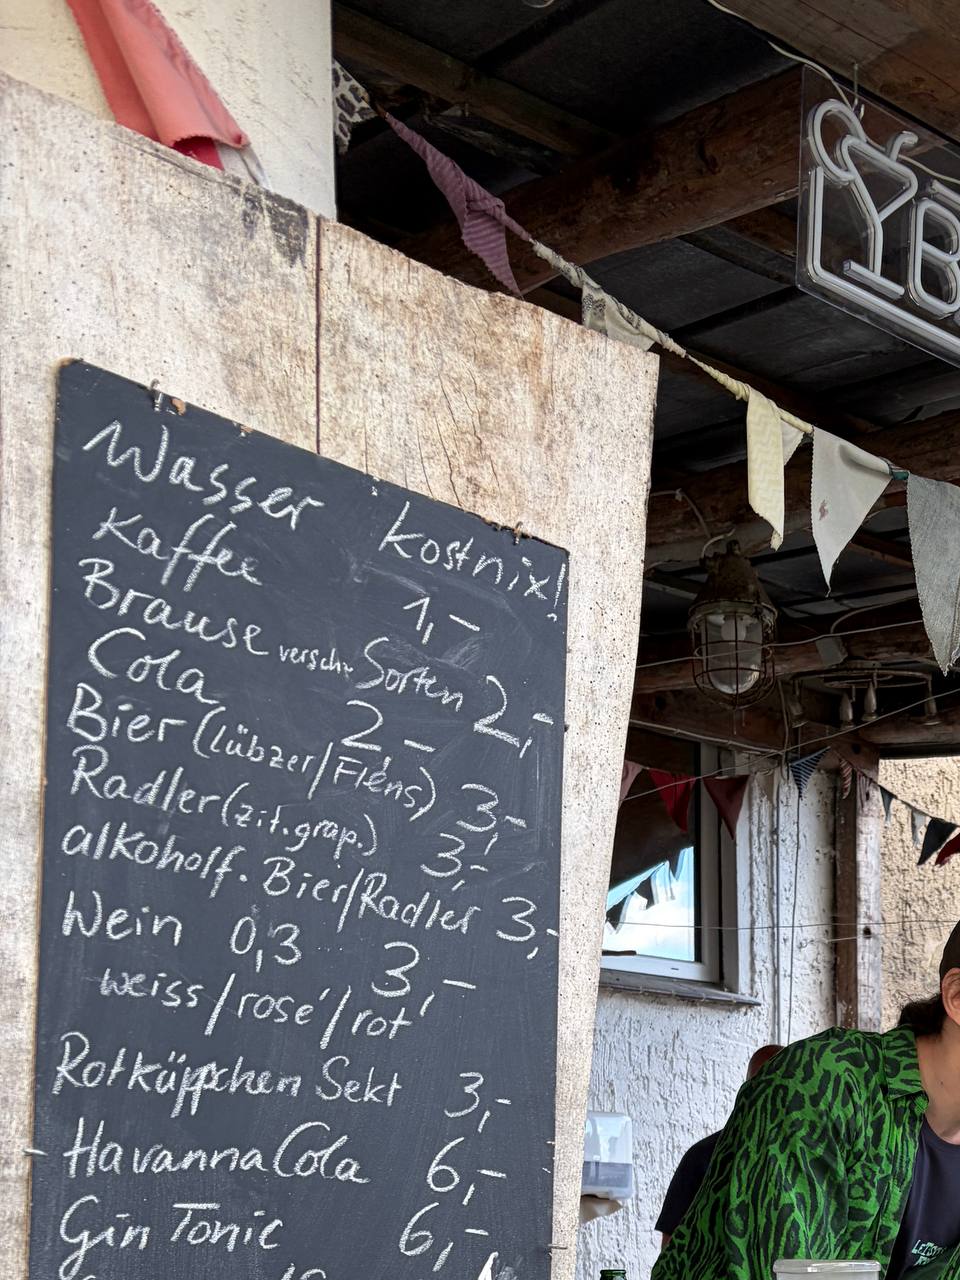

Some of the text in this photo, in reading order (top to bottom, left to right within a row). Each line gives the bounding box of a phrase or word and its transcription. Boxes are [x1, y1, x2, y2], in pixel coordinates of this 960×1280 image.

[83, 420, 324, 530] Wasser
[92, 507, 263, 592] Kaffee
[78, 558, 269, 656] Brause
[356, 637, 465, 710] Sorten
[87, 627, 220, 704] Cola
[67, 683, 187, 743] Bier
[62, 821, 248, 898] alkoholf.
[62, 890, 301, 972] Wein 0,3
[316, 1056, 402, 1107] Sekt
[173, 1203, 284, 1252] Tonic
